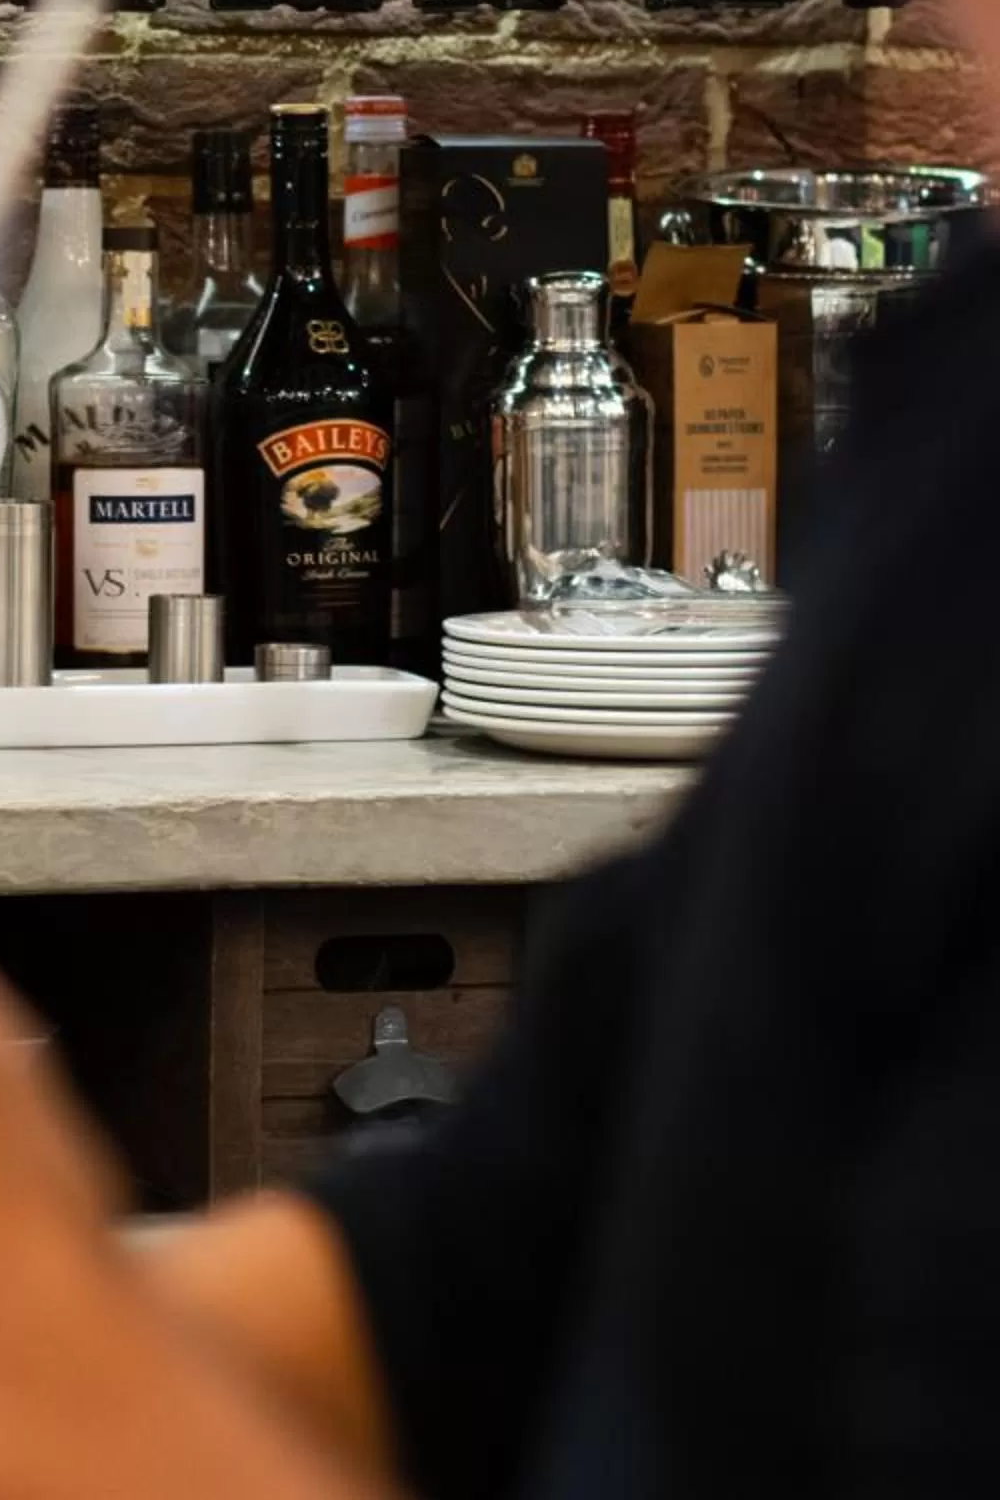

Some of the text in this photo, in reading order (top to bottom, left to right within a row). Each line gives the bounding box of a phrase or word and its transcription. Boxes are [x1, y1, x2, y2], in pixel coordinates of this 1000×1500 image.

[271, 426, 388, 466] BAILEYS
[96, 500, 193, 519] MARTELL
[286, 550, 380, 567] ORIGINAL
